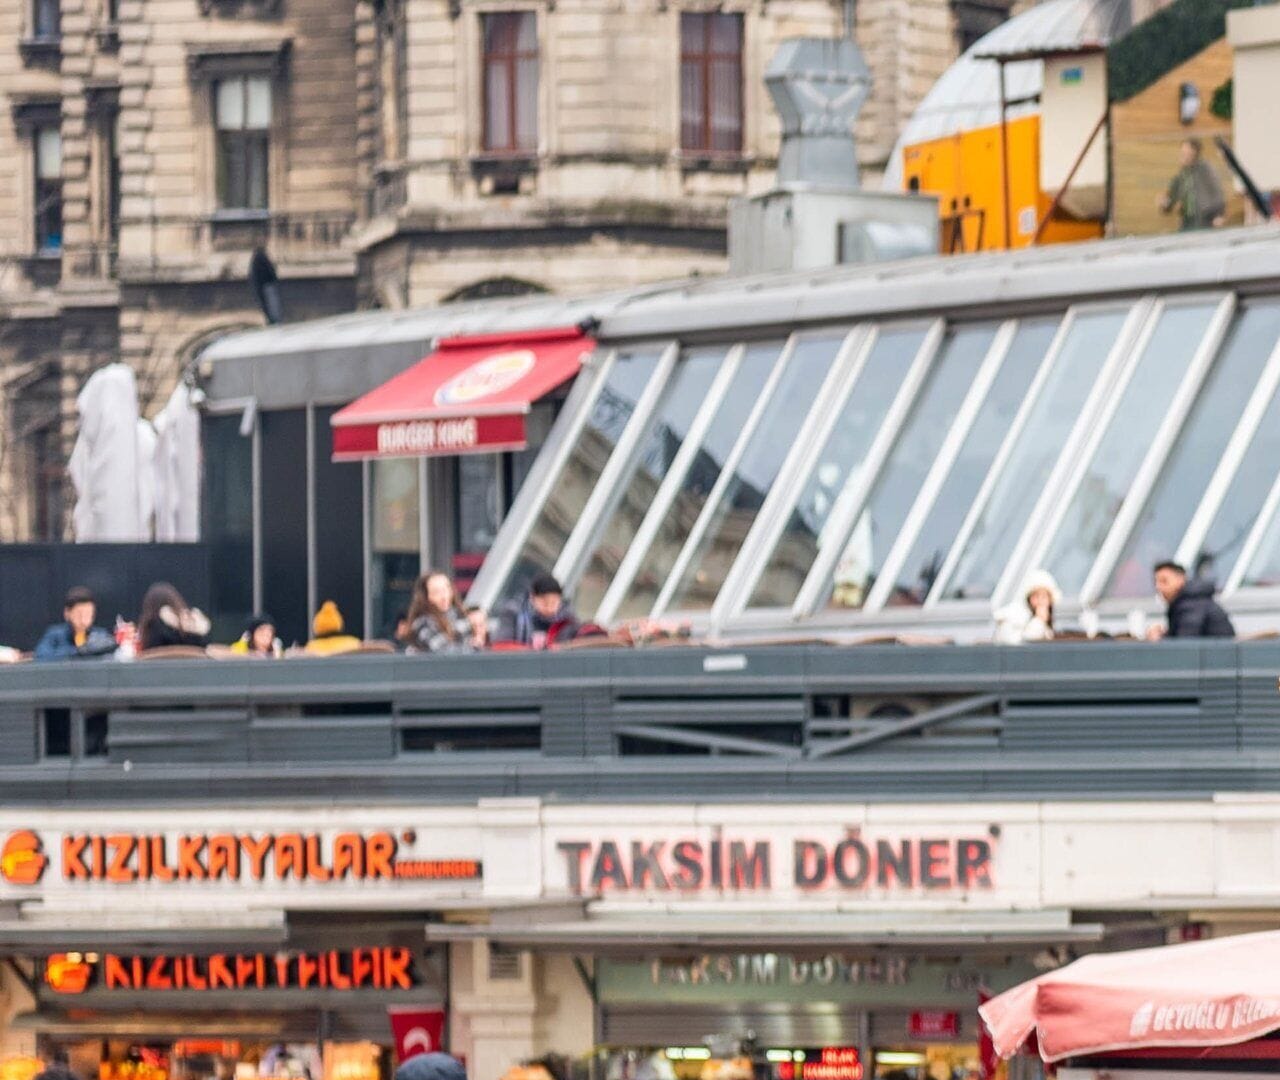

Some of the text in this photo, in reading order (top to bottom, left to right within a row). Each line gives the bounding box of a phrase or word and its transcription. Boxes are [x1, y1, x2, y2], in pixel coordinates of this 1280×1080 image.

[61, 831, 398, 882] KIZILKAYALAR
[557, 823, 995, 890] TAKSİM DÖNER
